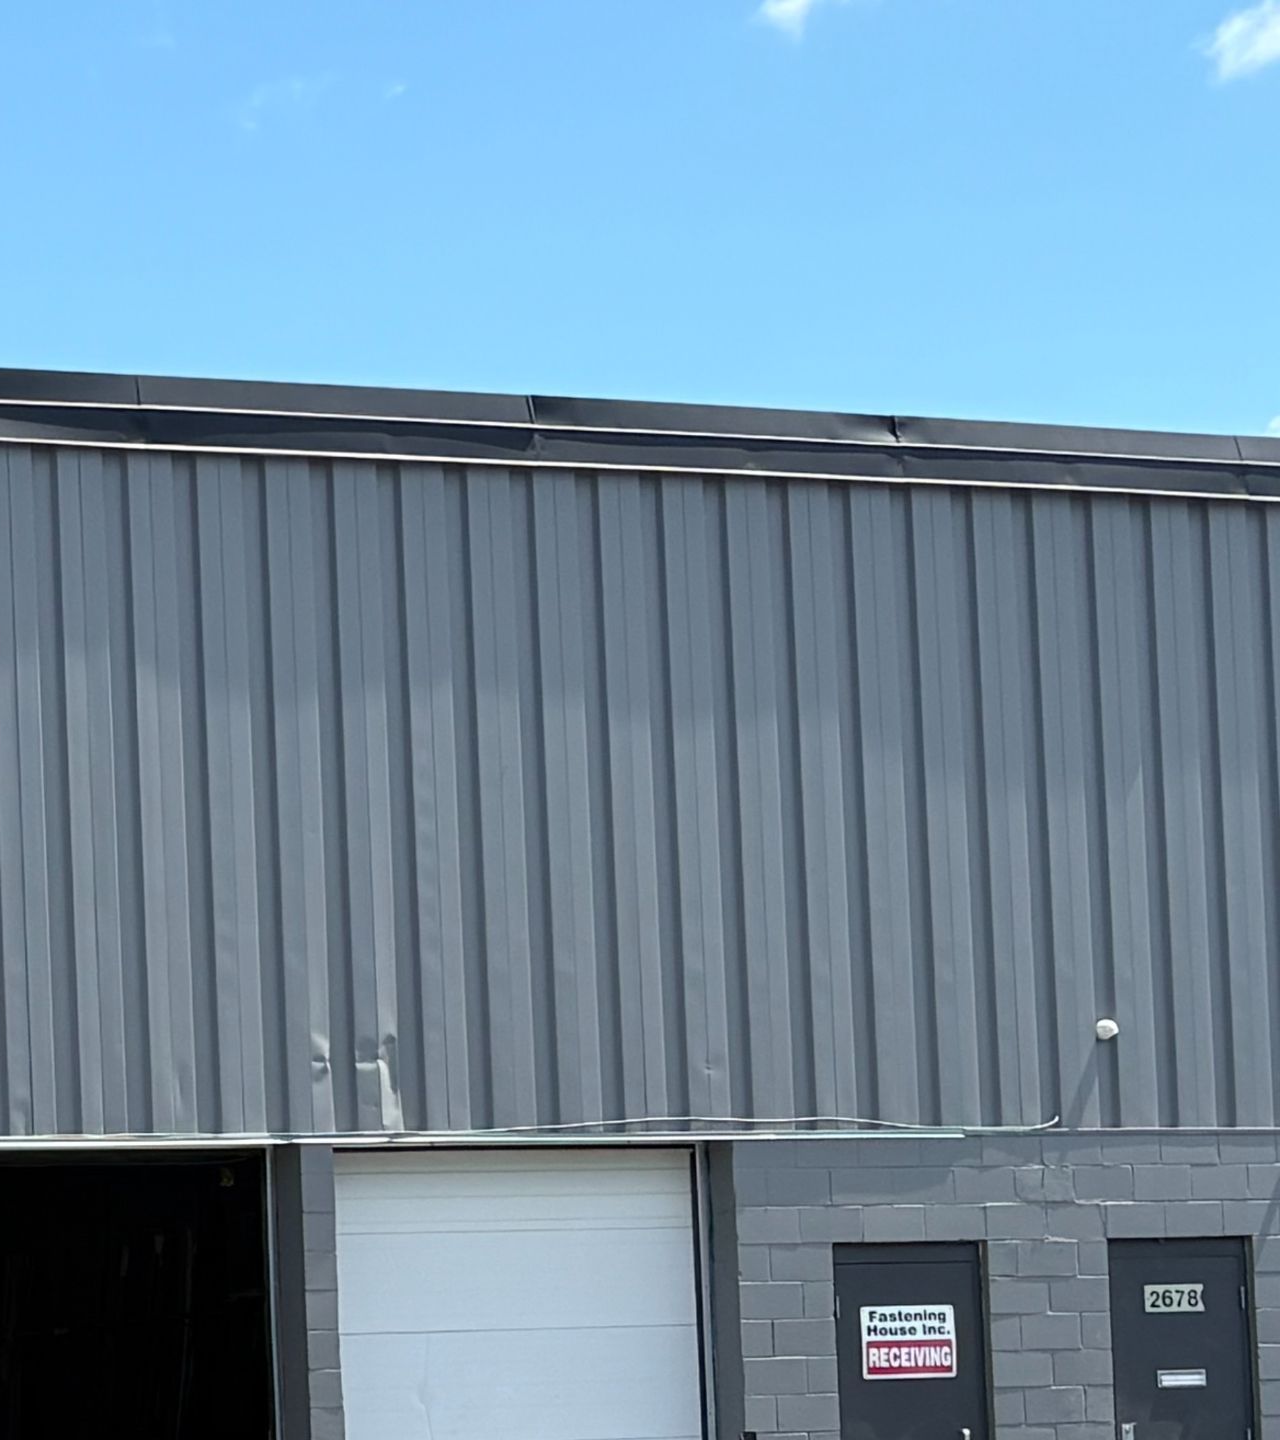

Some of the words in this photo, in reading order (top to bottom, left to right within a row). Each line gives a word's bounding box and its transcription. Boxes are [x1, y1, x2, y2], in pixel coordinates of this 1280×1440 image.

[1149, 1289, 1199, 1308] 2678
[868, 1309, 946, 1323] Fastening
[866, 1324, 918, 1336] House
[922, 1323, 951, 1336] Inc.
[868, 1346, 952, 1368] RECEIVING
